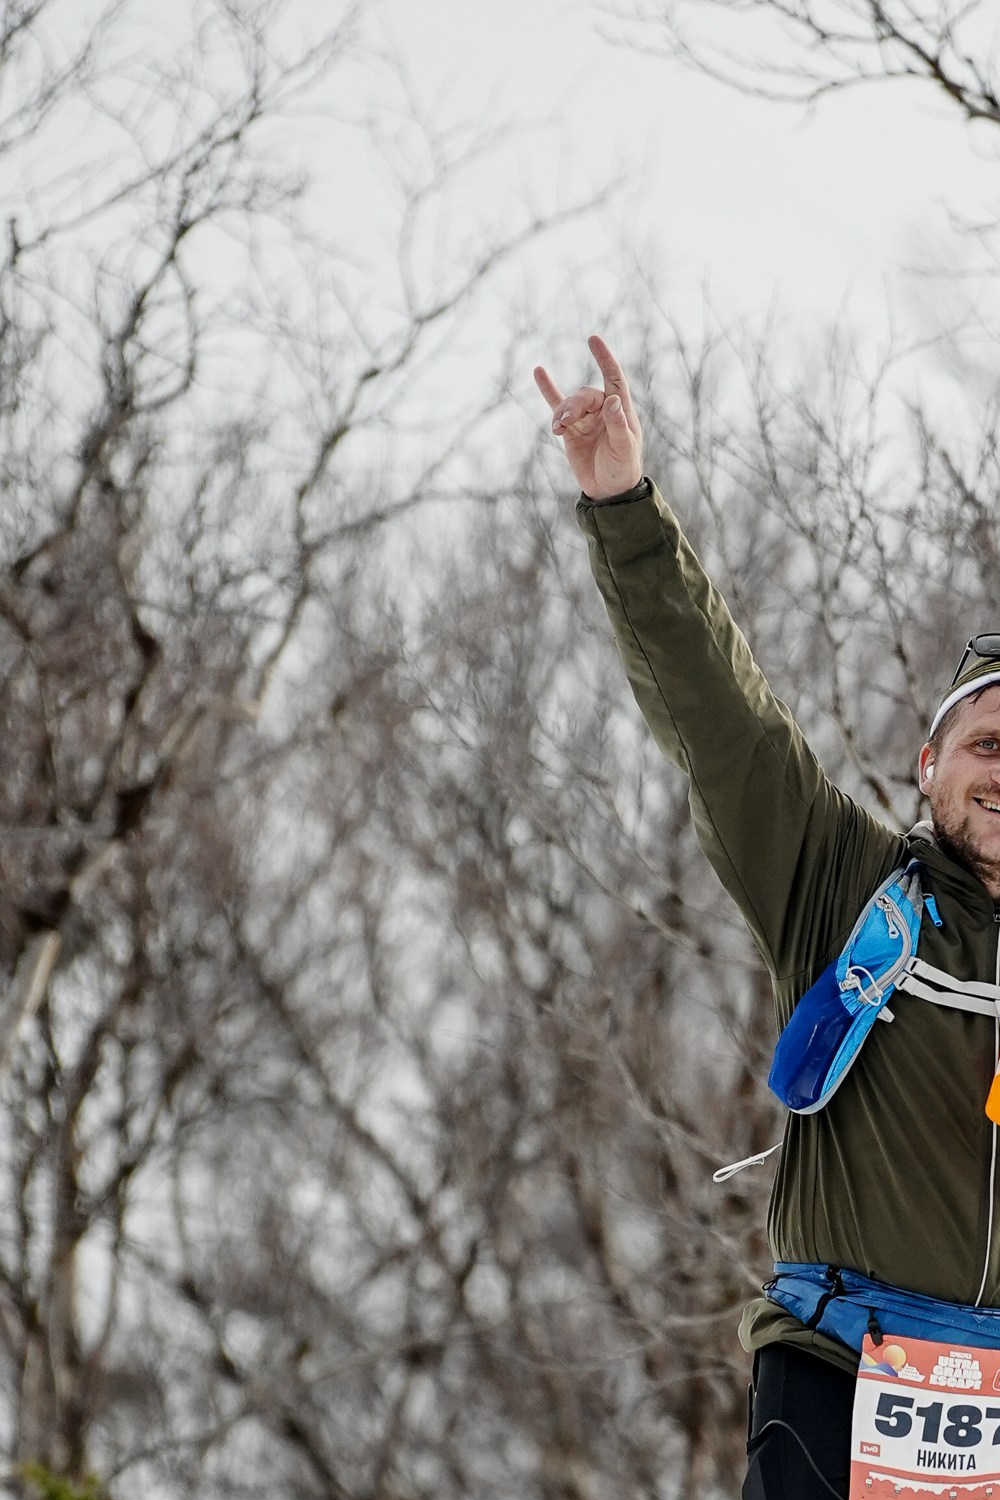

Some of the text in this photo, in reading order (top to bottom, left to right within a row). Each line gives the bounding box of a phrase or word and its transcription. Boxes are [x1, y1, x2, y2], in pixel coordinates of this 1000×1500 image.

[938, 1355, 980, 1371] ULTRA
[932, 1365, 983, 1381] GRAND
[916, 1449, 977, 1471] НИКИТА
